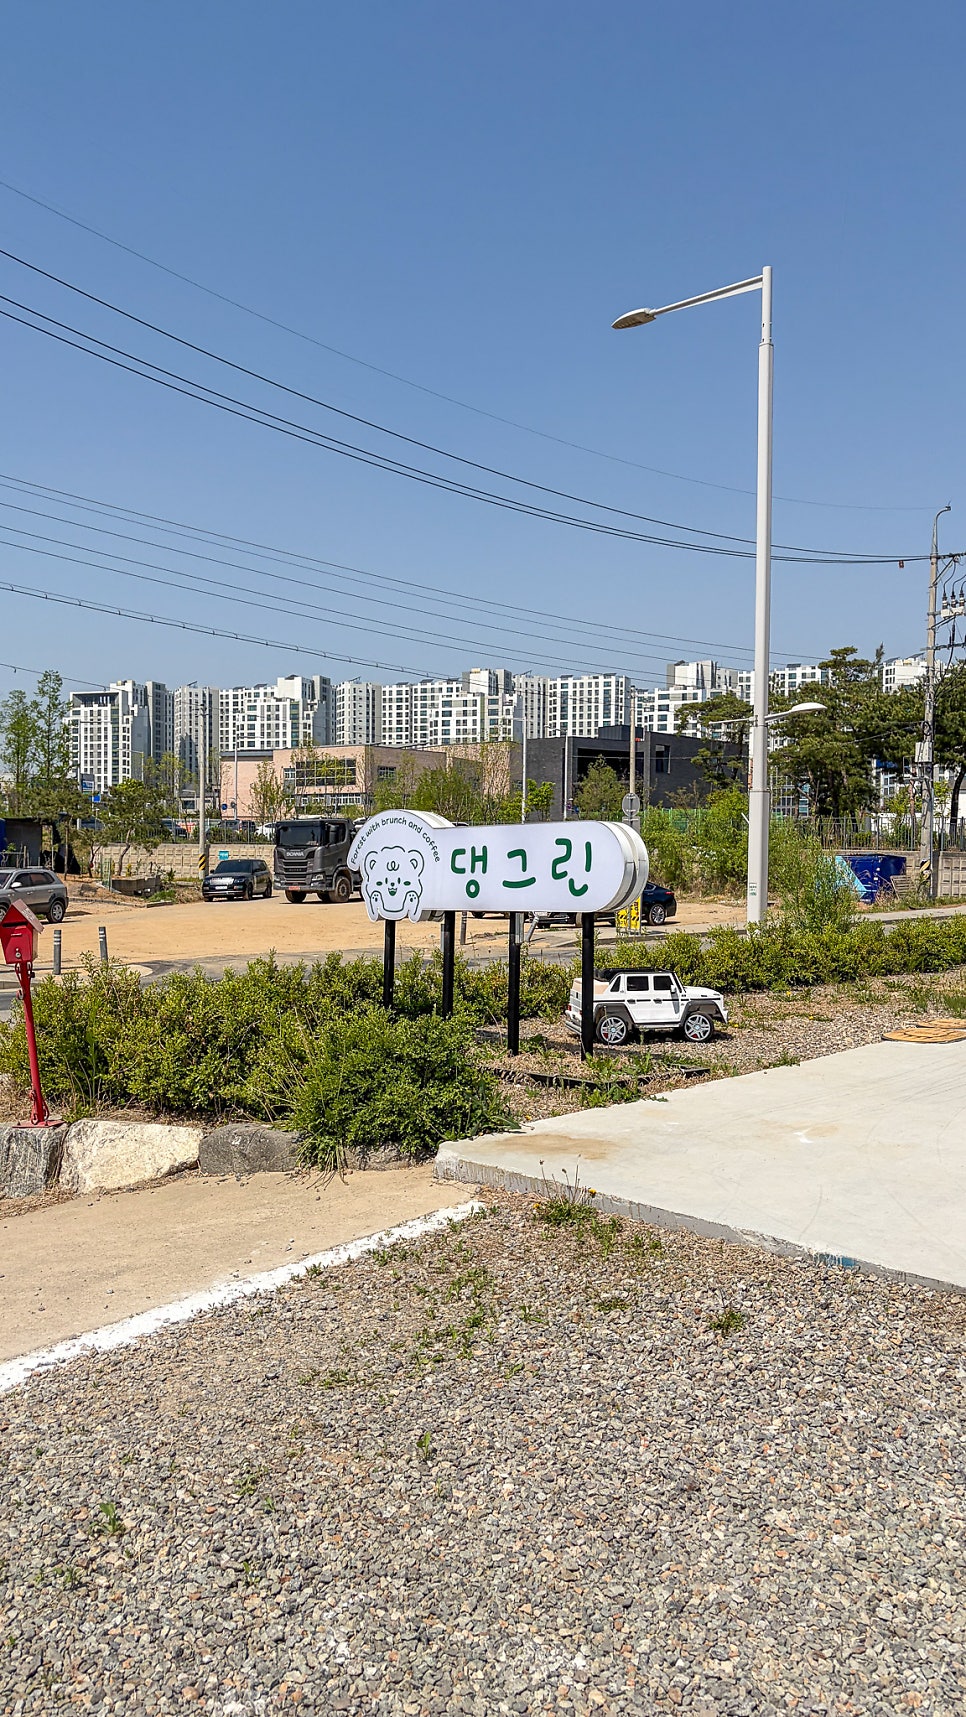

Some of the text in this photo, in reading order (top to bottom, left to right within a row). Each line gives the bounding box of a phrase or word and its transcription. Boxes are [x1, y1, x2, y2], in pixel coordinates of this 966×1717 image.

[351, 816, 441, 865] Forest with brunch and coffee
[450, 838, 592, 898] 댕그린
